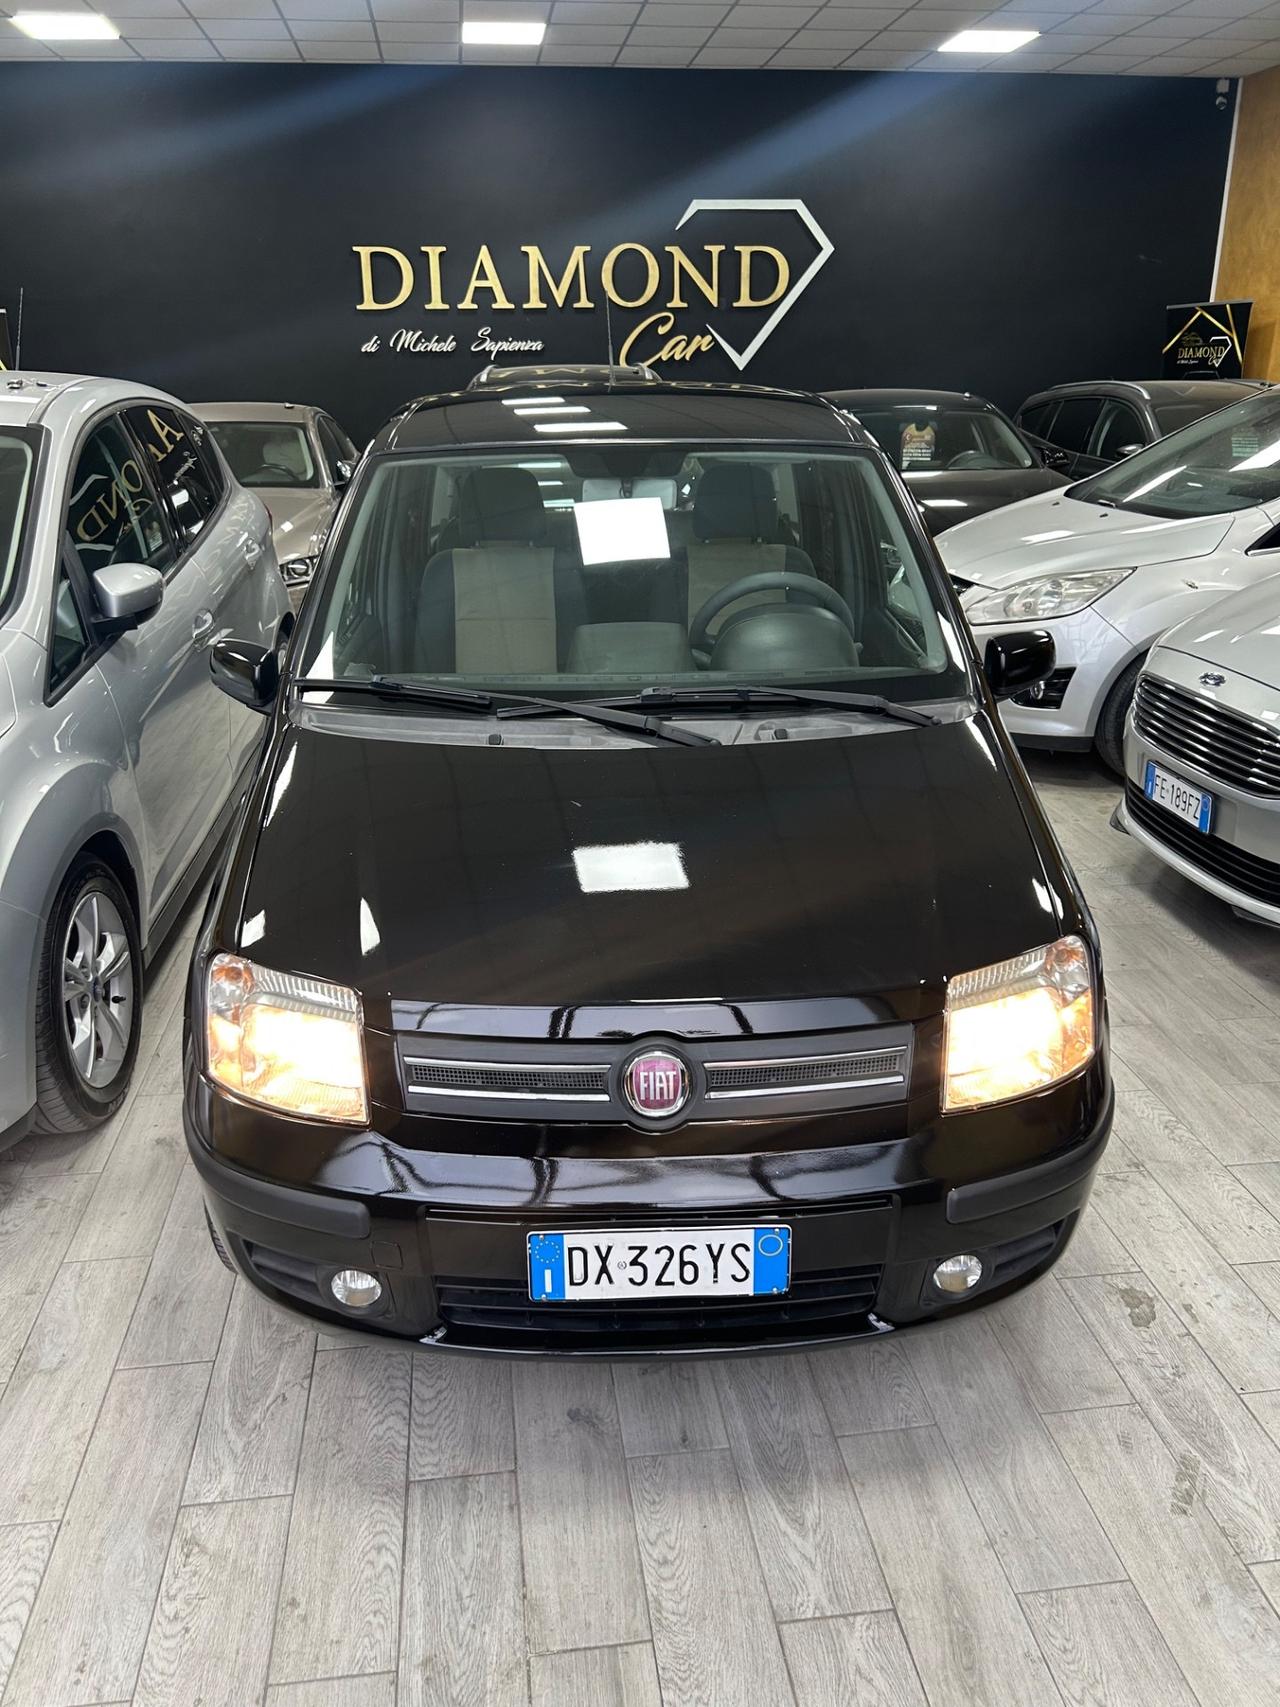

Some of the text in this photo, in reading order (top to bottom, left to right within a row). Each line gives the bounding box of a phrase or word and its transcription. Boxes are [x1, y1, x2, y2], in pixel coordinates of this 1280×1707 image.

[352, 242, 791, 312] DIAMOND
[361, 326, 545, 361] di Michele Sapienza
[619, 311, 715, 368] Car
[1178, 347, 1225, 359] DIAMOND
[640, 1071, 677, 1101] FIAT
